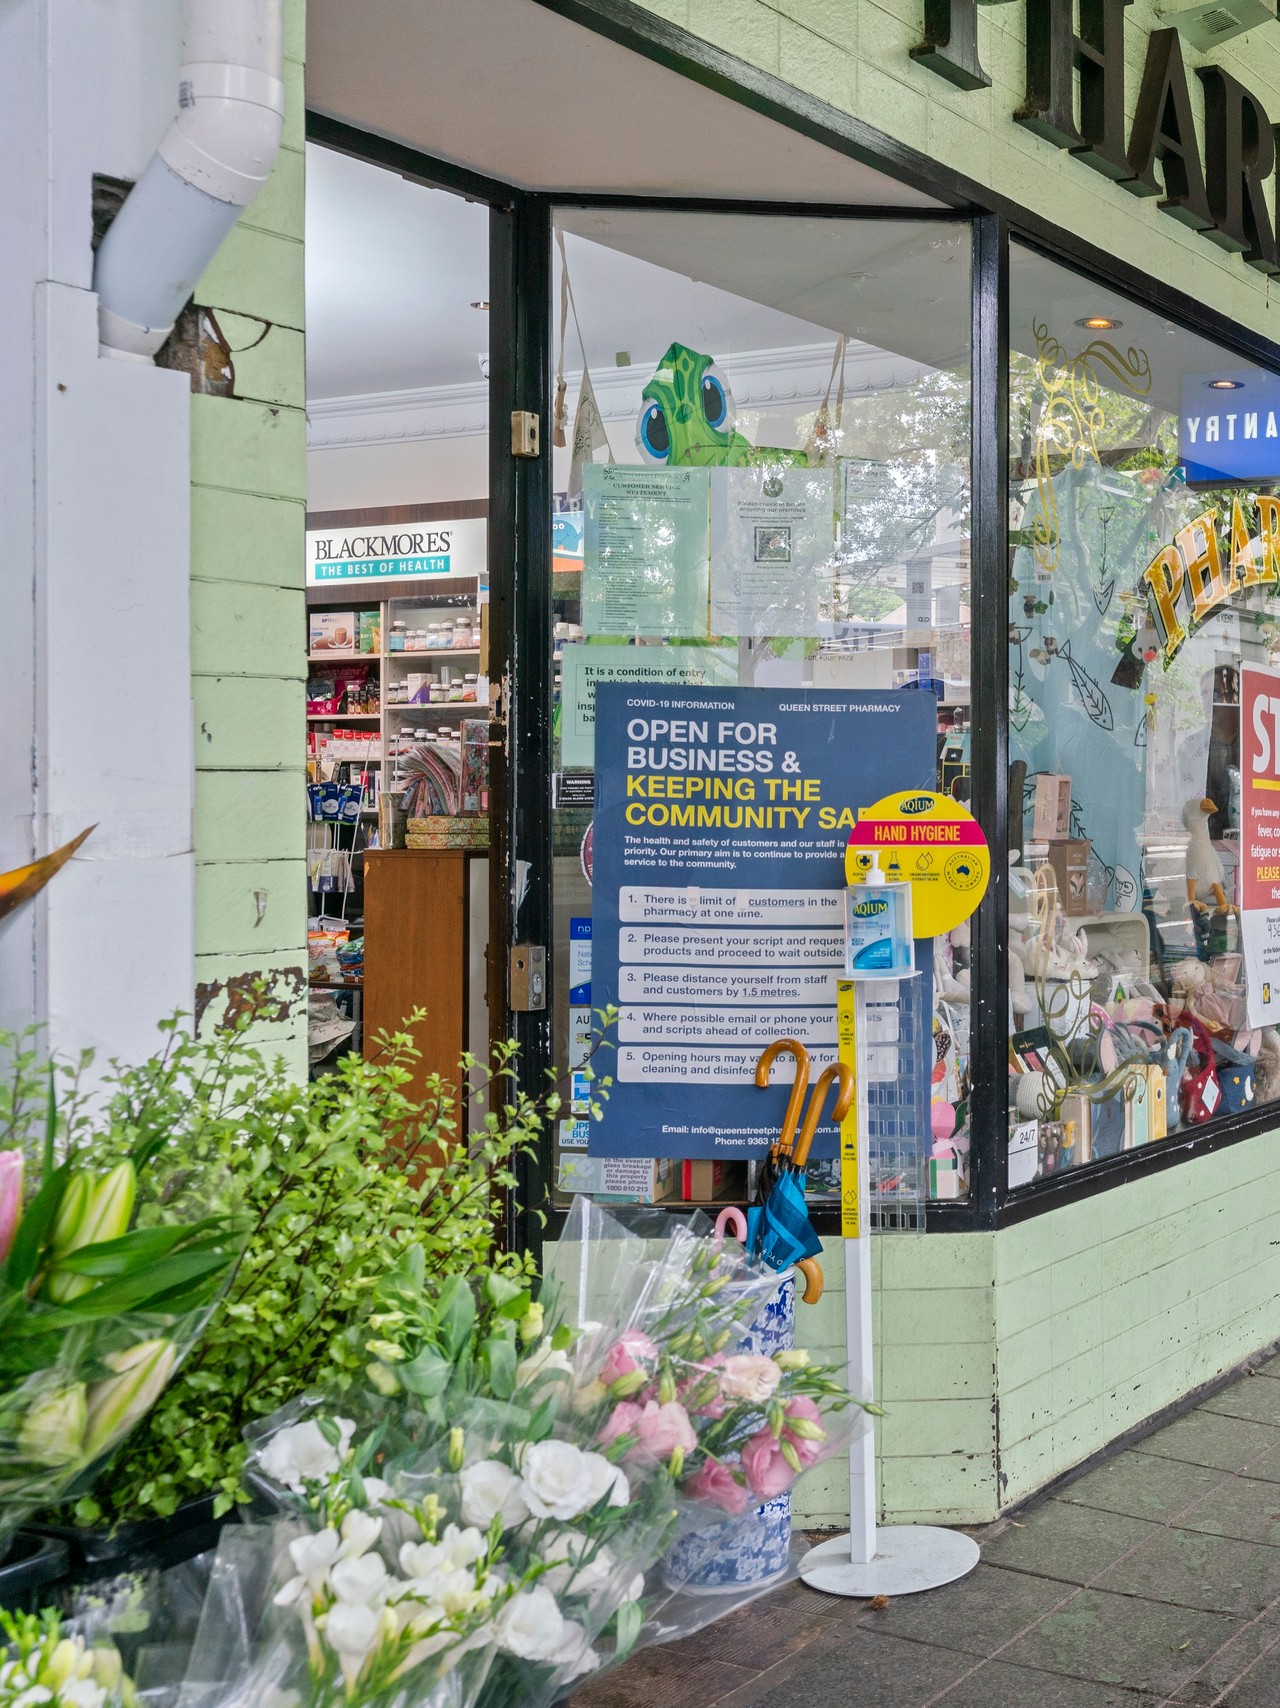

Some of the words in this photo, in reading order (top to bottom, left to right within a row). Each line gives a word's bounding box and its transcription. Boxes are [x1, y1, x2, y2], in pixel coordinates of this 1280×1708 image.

[315, 531, 451, 561] BLACKMORES
[321, 563, 345, 576] THE
[348, 561, 375, 575] BEST
[379, 560, 396, 573] OF
[399, 557, 445, 572] HEALTH
[584, 667, 595, 676] It
[597, 667, 605, 676] is
[616, 667, 663, 676] condition
[666, 668, 677, 677] of
[679, 669, 706, 679] entry
[627, 699, 670, 708] COVID-19
[671, 700, 735, 710] INFORMATION
[779, 703, 811, 712] QUEEN
[812, 704, 847, 712] STREET
[849, 704, 901, 713] PHARMACY
[627, 718, 708, 743] OPEN
[718, 721, 777, 745] FOR
[627, 746, 774, 773] BUSINESS
[781, 751, 801, 773] &
[626, 774, 755, 800] KEEPING
[764, 778, 821, 801] THE
[625, 803, 811, 829] COMMUNITY
[1254, 808, 1262, 818] you
[1262, 807, 1272, 817] have
[1272, 809, 1280, 819] any
[874, 825, 907, 841] HAND
[911, 825, 961, 841] HYGIENE
[624, 836, 641, 845] The
[643, 836, 671, 845] health
[673, 837, 690, 846] and
[691, 837, 718, 848] safety
[720, 838, 730, 846] of
[731, 839, 778, 848] customers
[780, 839, 797, 848] and
[799, 840, 814, 848] our
[815, 839, 836, 848] staff
[837, 839, 845, 848] is
[1251, 844, 1271, 860] fatigue
[1271, 848, 1278, 856] or
[1256, 865, 1280, 879] PLEASE
[1271, 886, 1280, 899] the
[628, 894, 637, 903] 1.
[644, 894, 675, 904] There
[677, 895, 687, 905] is
[699, 895, 723, 905] limit
[725, 896, 736, 905] of
[748, 897, 805, 907] customers
[808, 896, 818, 906] in
[820, 897, 837, 906] the
[644, 907, 697, 919] pharmacy
[700, 909, 712, 917] at
[714, 910, 734, 918] one
[627, 933, 637, 943] 2.
[644, 934, 680, 943] Please
[682, 936, 724, 946] present
[726, 937, 750, 947] your
[753, 936, 784, 947] script
[786, 936, 807, 946] and
[662, 1125, 689, 1134] Email:
[1020, 1129, 1035, 1144] 24/7
[715, 1137, 746, 1146] Phone:
[747, 1137, 768, 1146] 9363
